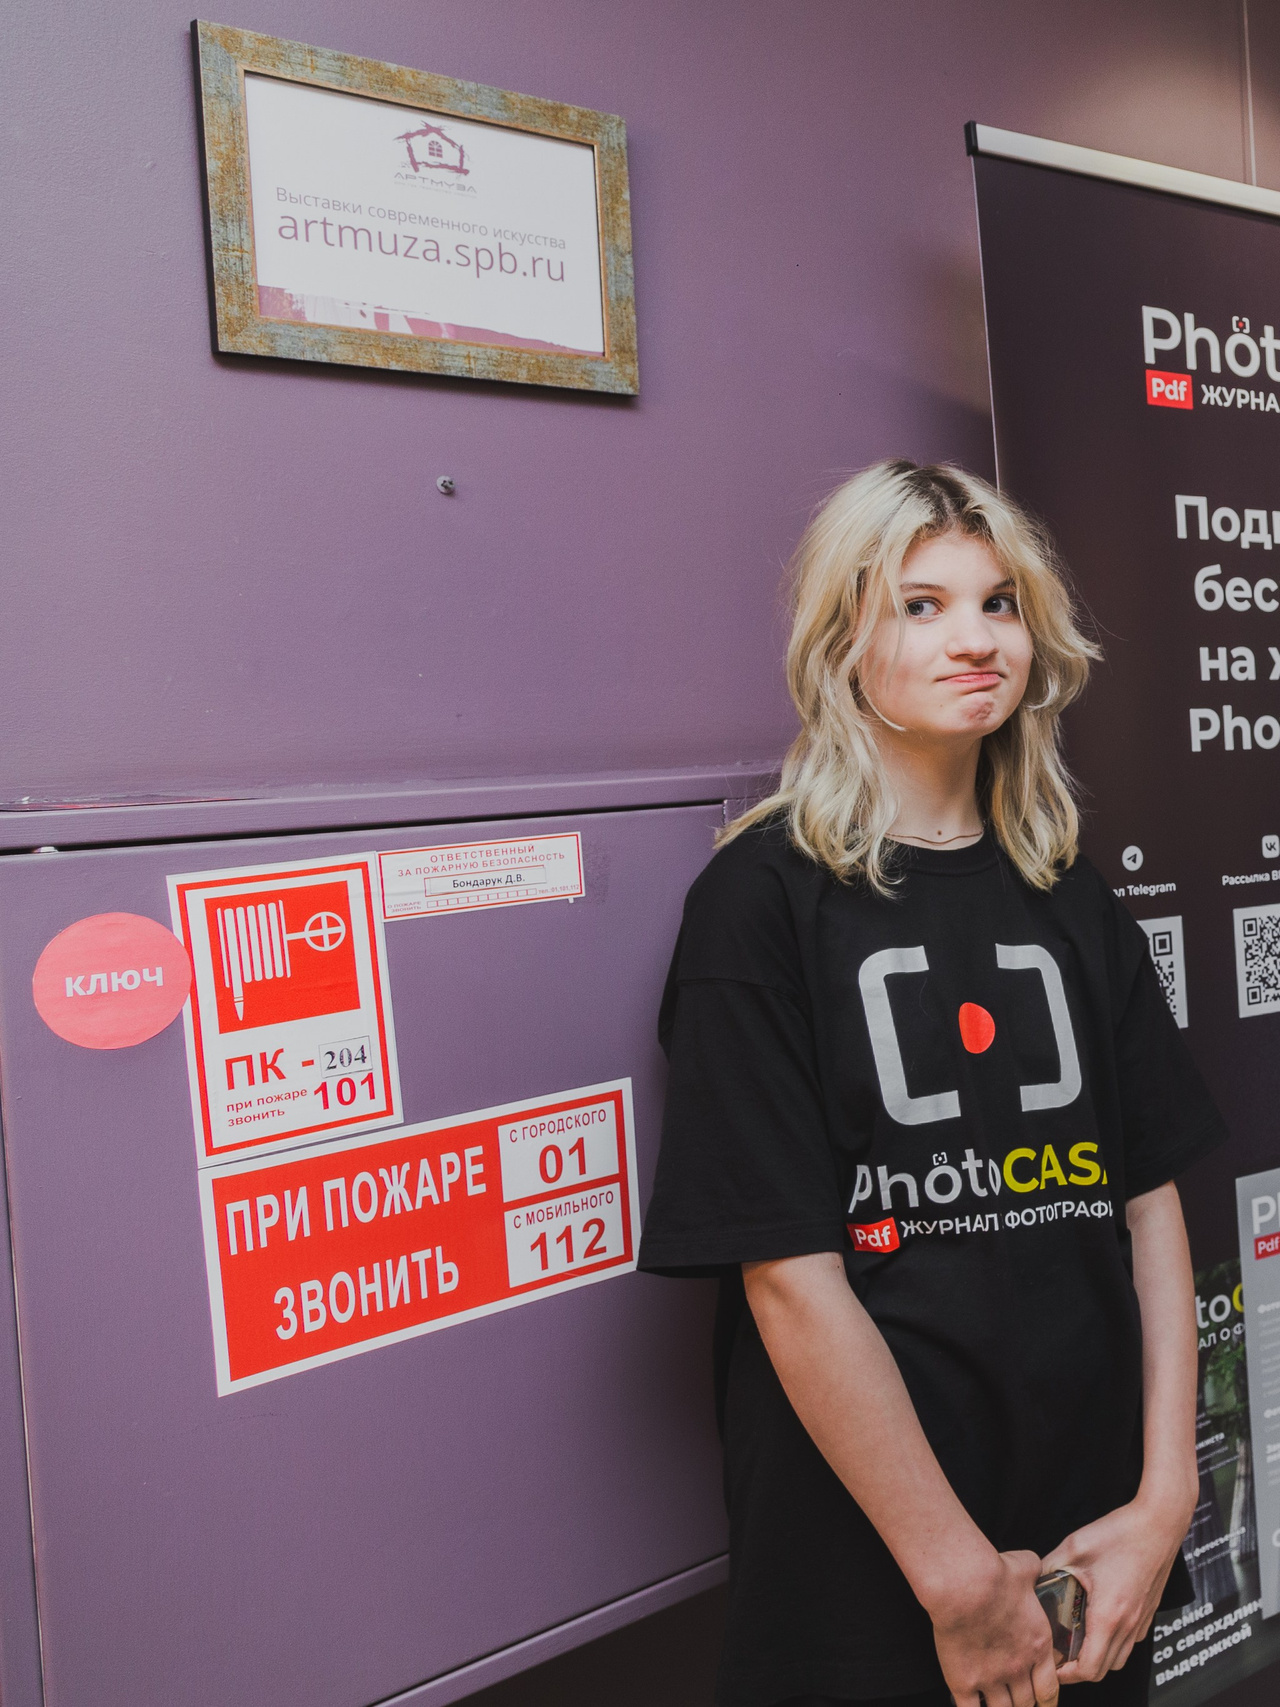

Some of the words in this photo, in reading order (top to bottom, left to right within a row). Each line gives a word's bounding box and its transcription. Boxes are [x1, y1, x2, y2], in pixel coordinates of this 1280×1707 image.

[276, 187, 362, 215] Выставки
[368, 205, 488, 236] современного
[493, 228, 566, 249] искусства
[278, 215, 565, 282] artmuza.spb.ru
[1151, 378, 1187, 402] Pdf
[1200, 646, 1256, 681] на
[398, 869, 412, 877] ЗА
[416, 862, 479, 875] ПОЖАРНУЮ
[482, 852, 565, 868] БЕЗОПАСНОСТЬ
[430, 845, 535, 863] ОТВЕТСТВЕННЫЙ
[453, 876, 502, 889] Бондарук
[505, 873, 526, 884] Д.В.
[1127, 882, 1176, 896] Telegram
[1222, 874, 1270, 886] Рассылка
[225, 1048, 286, 1090] ПК
[324, 1044, 367, 1071] 204
[226, 1100, 252, 1113] при
[257, 1088, 307, 1105] пожаре
[314, 1072, 376, 1110] 101
[228, 1108, 285, 1127] звонить
[510, 1129, 518, 1143] С
[522, 1109, 607, 1139] ГОРОДСКОГО
[539, 1137, 588, 1184] 01
[225, 1185, 311, 1256] ПРИ
[322, 1145, 487, 1233] ПОЖАРЕ
[513, 1215, 522, 1229] С
[526, 1190, 614, 1225] МОБИЛЬНОГО
[855, 1225, 891, 1247] Pdf
[900, 1213, 999, 1238] ЖУРНАЛ
[530, 1217, 607, 1271] 112
[1257, 1236, 1280, 1255] Pdf
[273, 1246, 460, 1341] ЗВОНИТЬ
[1153, 1646, 1174, 1664] со
[1155, 1622, 1252, 1687] выдержкой
